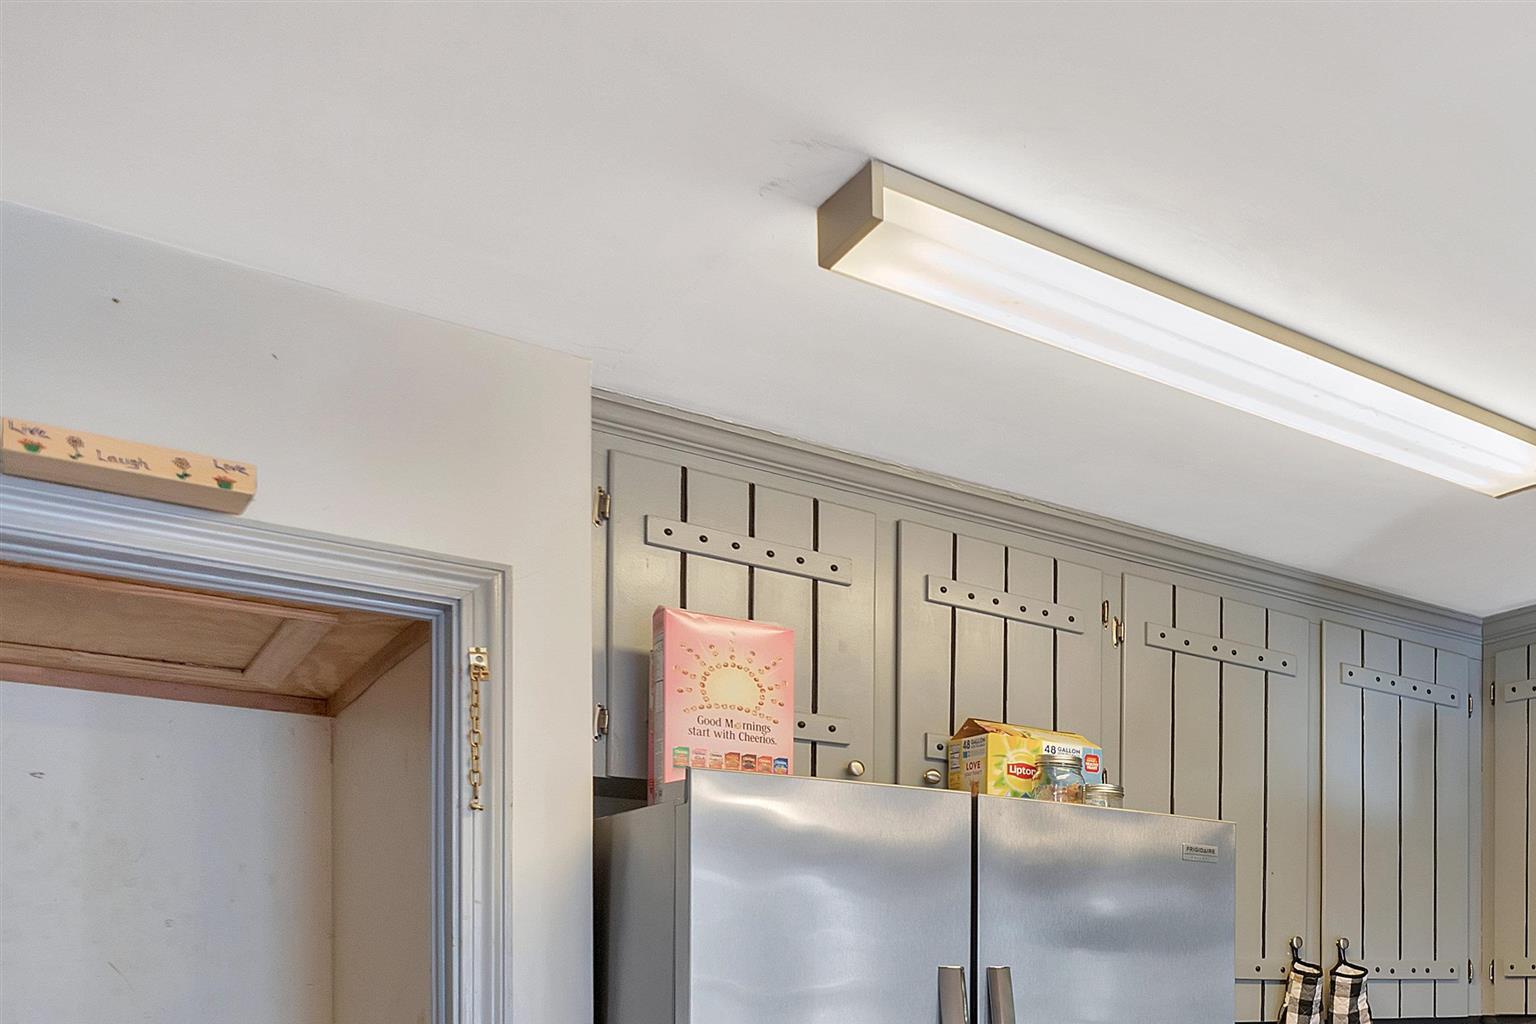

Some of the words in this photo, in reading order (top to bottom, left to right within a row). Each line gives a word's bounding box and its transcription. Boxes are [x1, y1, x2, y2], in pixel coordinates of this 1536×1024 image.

[96, 449, 151, 471] Laugh
[697, 714, 722, 728] Good
[688, 728, 710, 738] start
[714, 729, 736, 740] with
[738, 731, 778, 746] Cheerios.
[1044, 744, 1057, 755] 48
[1057, 746, 1081, 755] GALLON
[965, 760, 981, 771] LOVE
